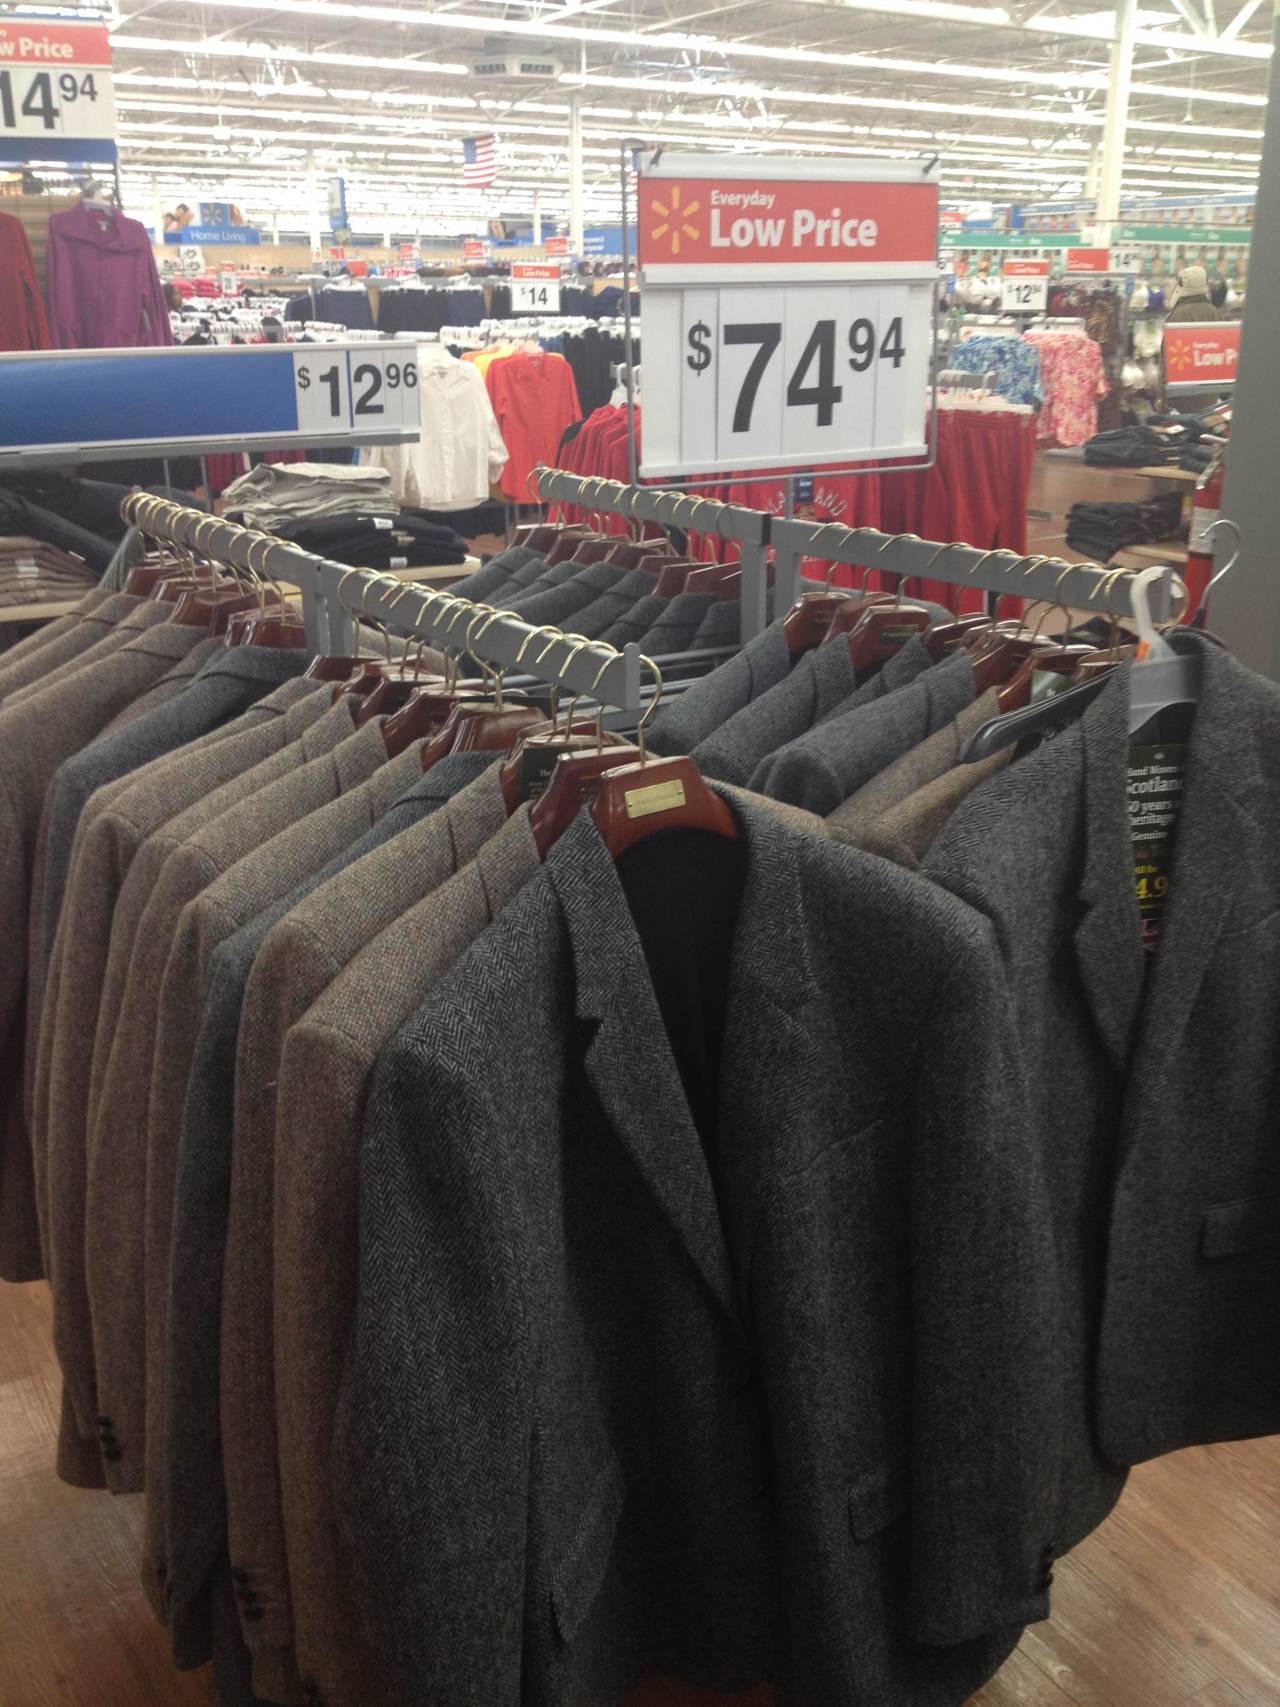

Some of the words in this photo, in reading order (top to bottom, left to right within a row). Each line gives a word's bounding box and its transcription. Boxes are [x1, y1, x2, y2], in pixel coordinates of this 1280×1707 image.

[19, 37, 74, 58] Price
[710, 189, 776, 209] Everyday
[190, 230, 220, 241] Home
[222, 231, 246, 244] Living
[710, 208, 786, 247] Low
[793, 207, 878, 247] Price
[1193, 349, 1224, 367] Low
